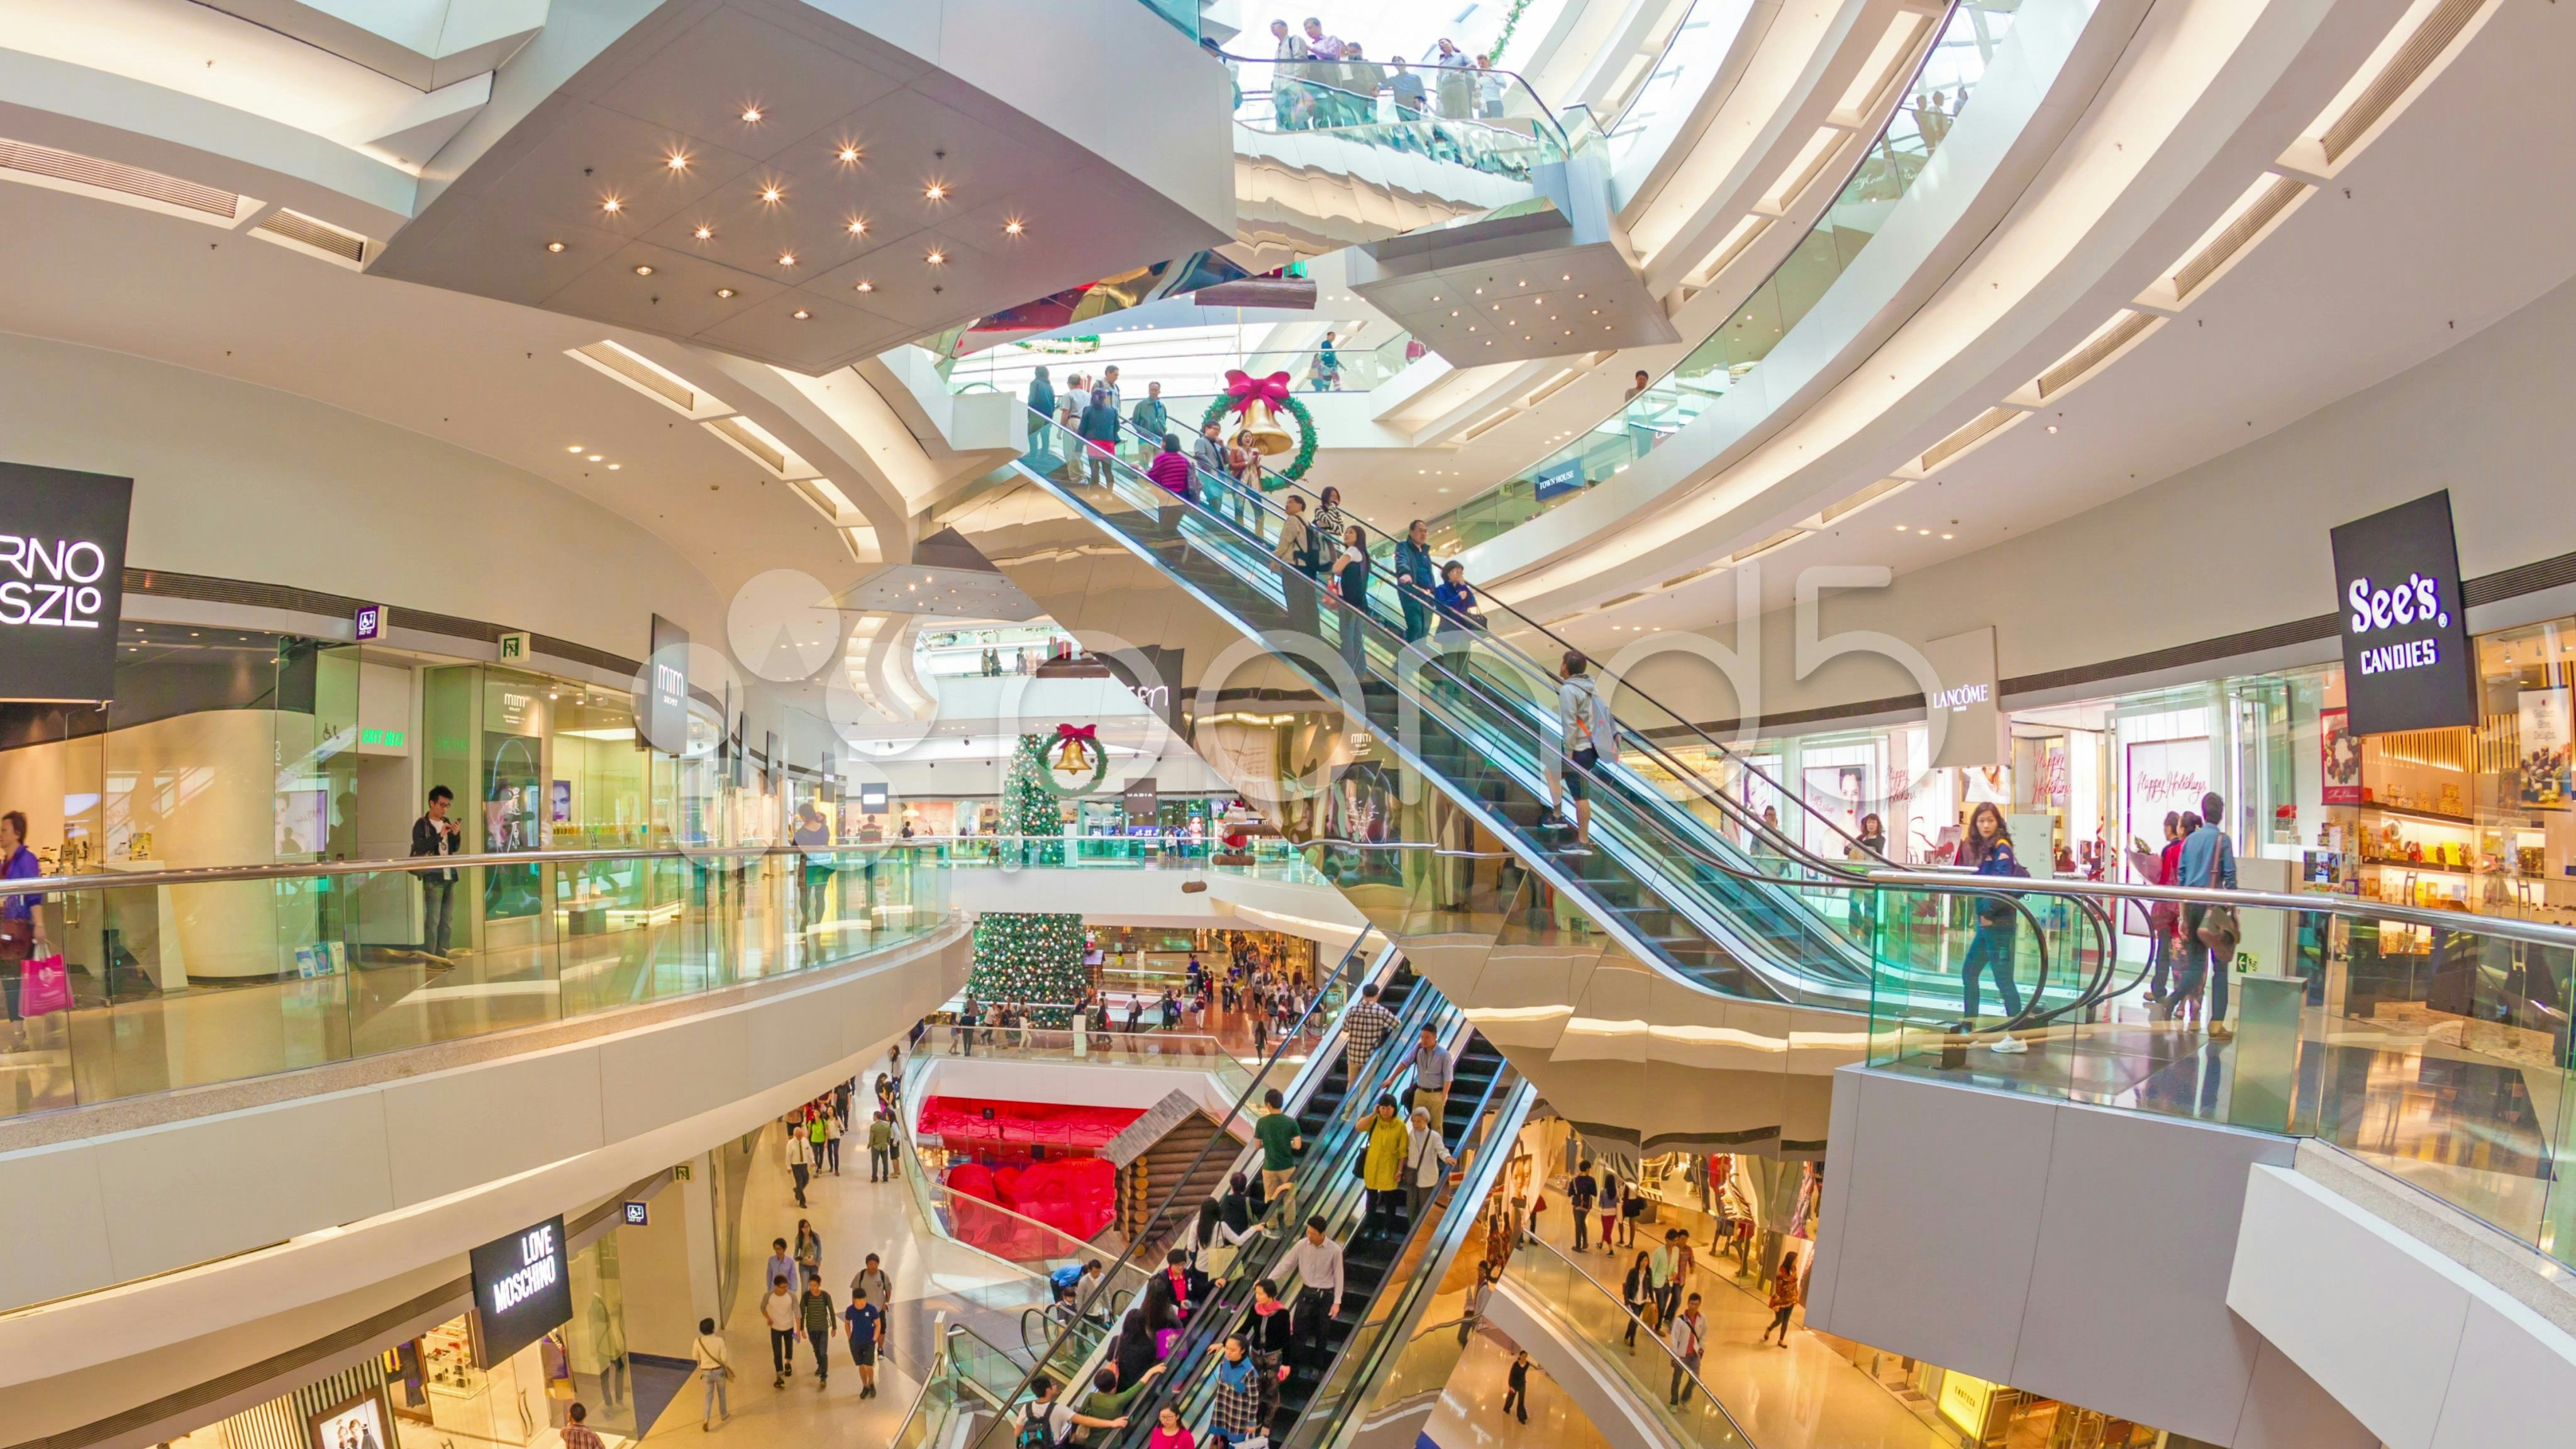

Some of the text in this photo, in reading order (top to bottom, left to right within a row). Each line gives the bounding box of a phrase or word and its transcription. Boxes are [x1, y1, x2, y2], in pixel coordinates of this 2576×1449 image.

[1540, 470, 1575, 490] TOWN HOUSE
[2349, 573, 2439, 634] See's
[2360, 638, 2438, 675] CANDIES
[1933, 684, 1989, 709] LANCÔME
[362, 728, 404, 747] EXIT 出口
[2137, 770, 2206, 804] Happy Holidays
[521, 1224, 555, 1267] LOVE
[492, 1255, 557, 1314] MOSCHINO
